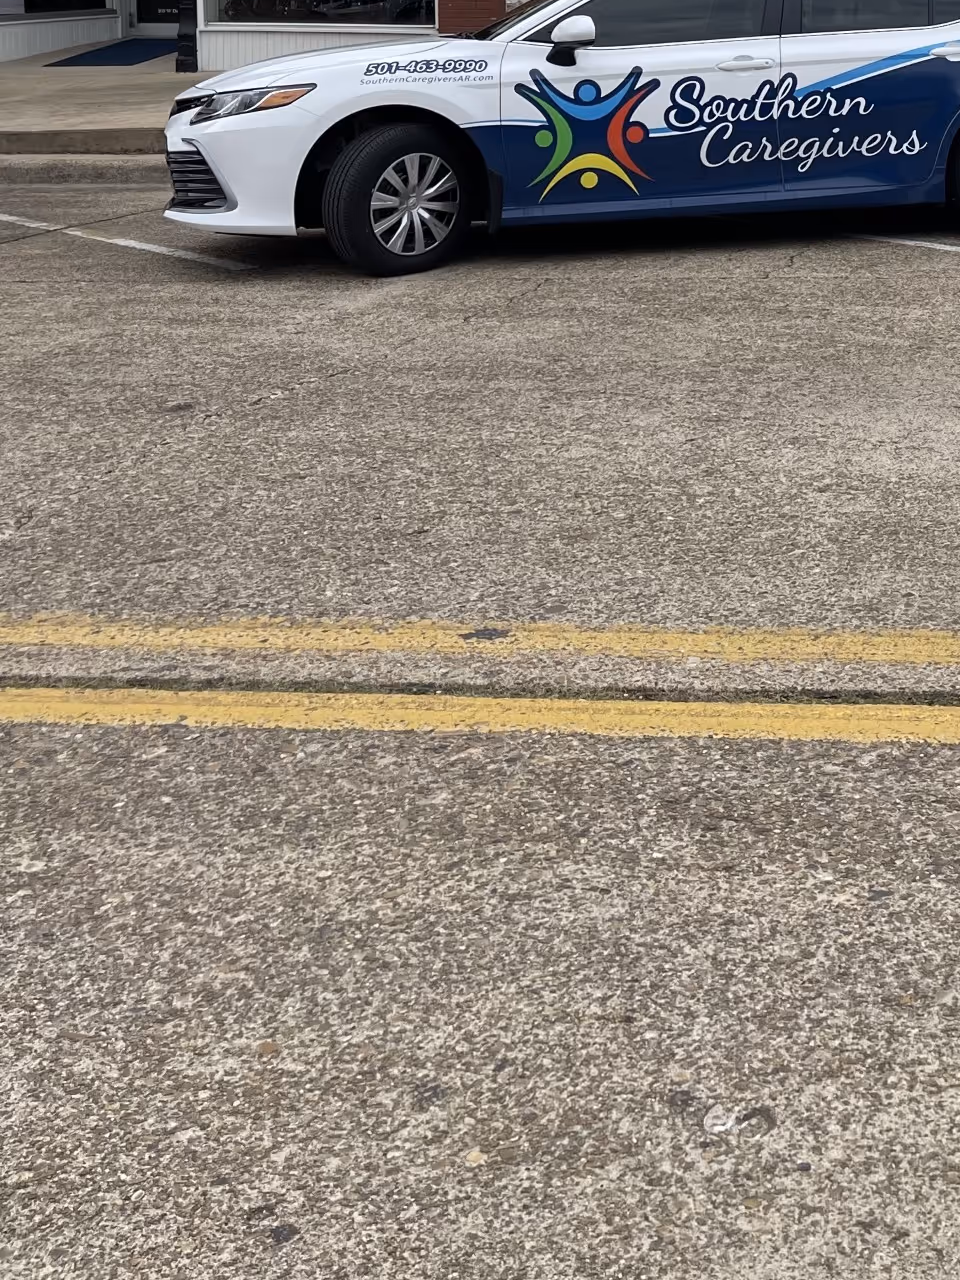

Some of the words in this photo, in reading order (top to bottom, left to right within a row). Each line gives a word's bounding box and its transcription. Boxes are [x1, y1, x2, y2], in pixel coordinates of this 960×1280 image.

[360, 75, 494, 85] SouthernCaregiversAR.com
[365, 60, 487, 75] 501-463-9990
[667, 76, 874, 128] Southern
[700, 122, 928, 172] Caregivers
